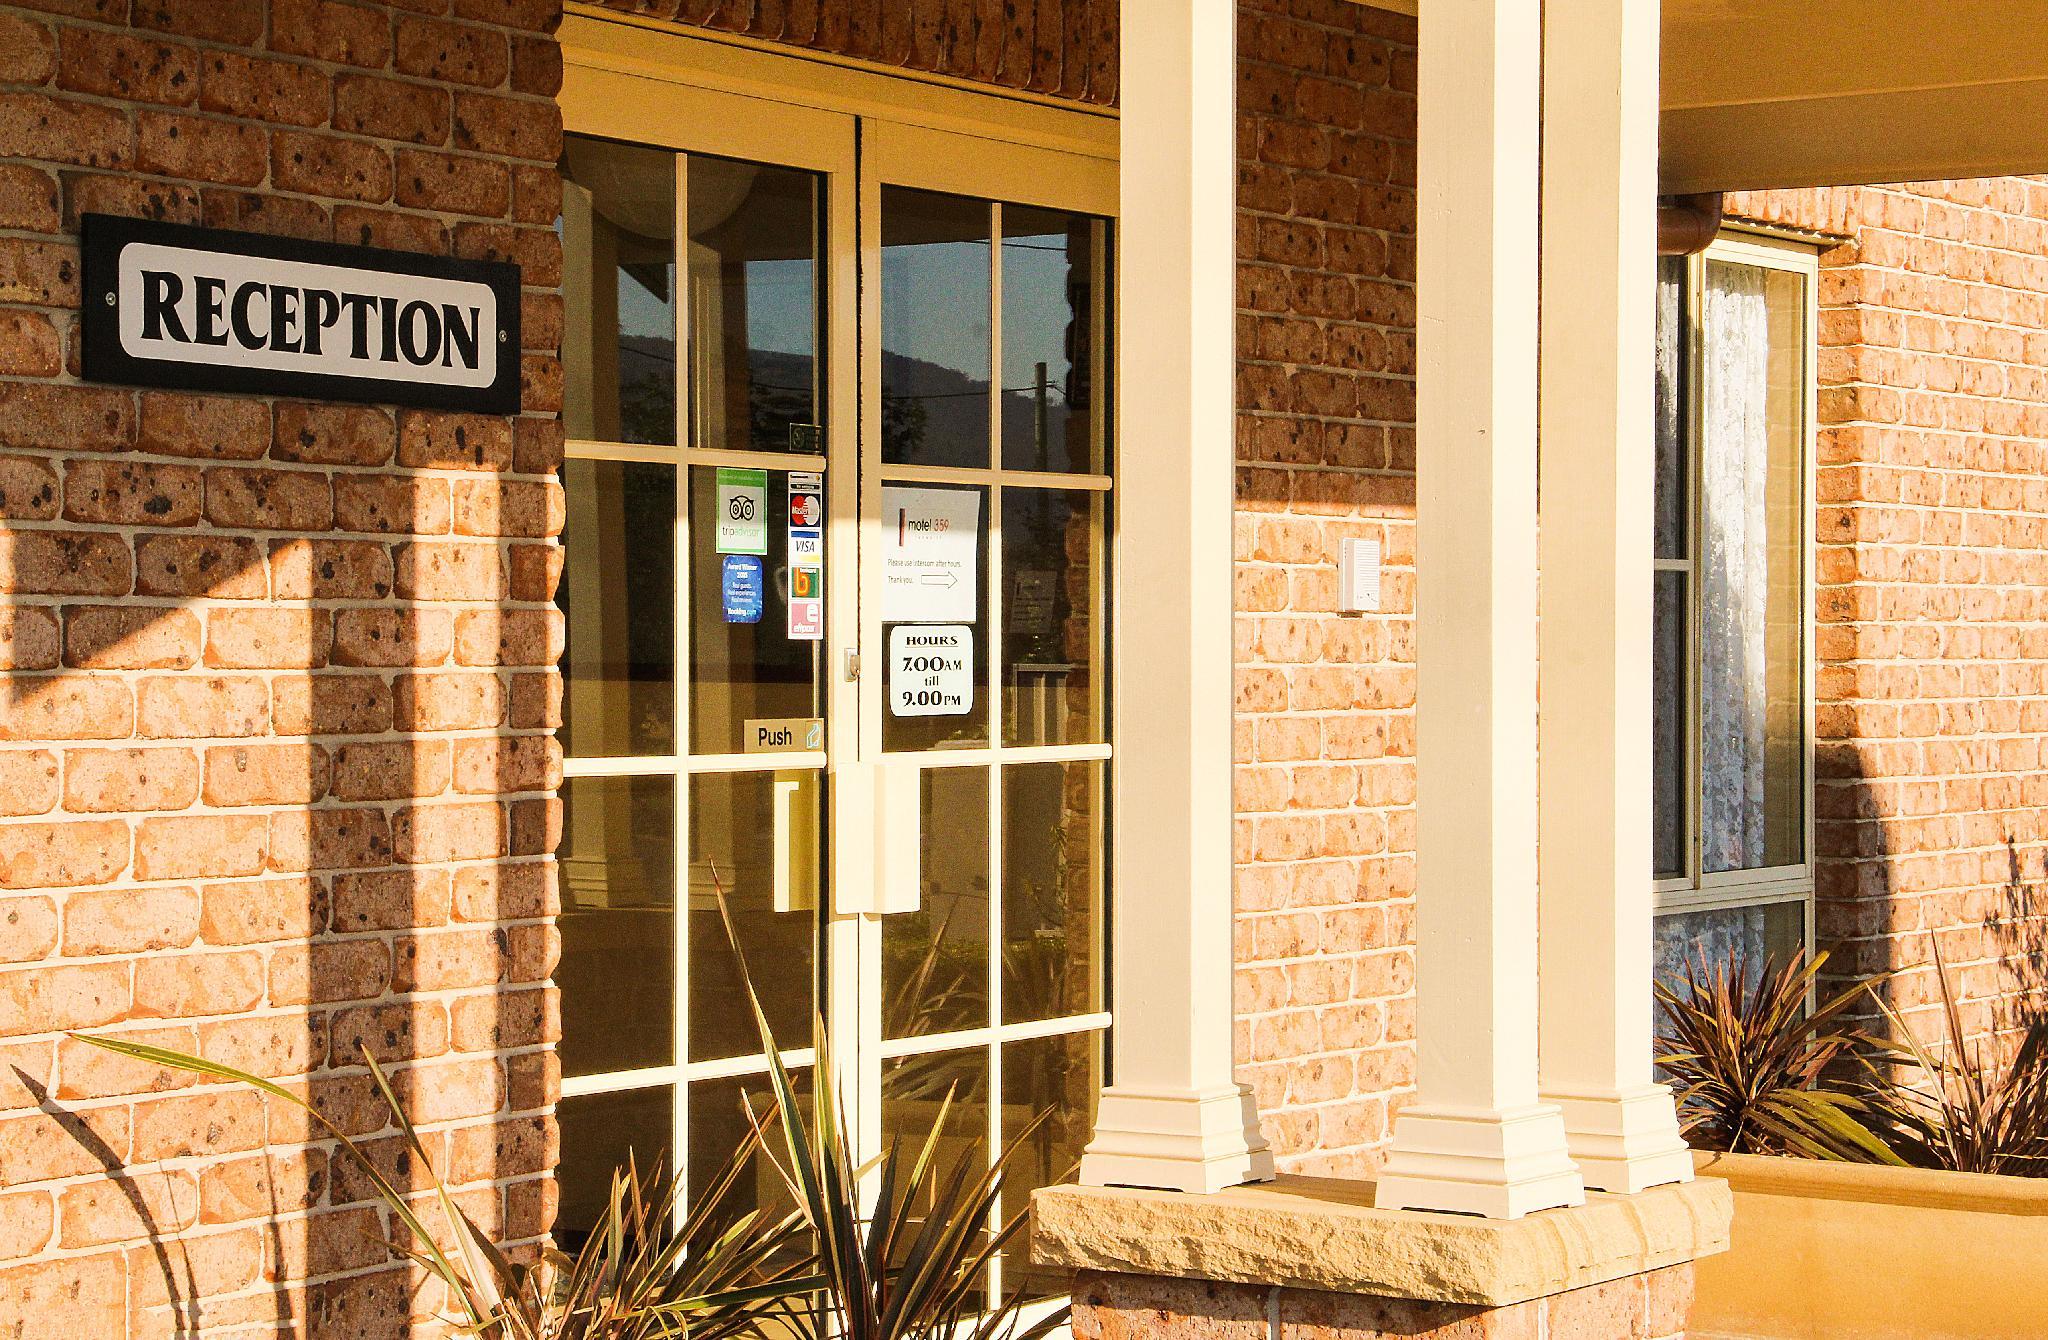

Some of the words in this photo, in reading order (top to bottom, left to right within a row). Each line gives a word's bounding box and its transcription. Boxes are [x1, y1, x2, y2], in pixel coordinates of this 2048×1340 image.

[140, 270, 481, 369] RECEPTION
[908, 518, 932, 531] motel
[934, 518, 950, 531] 359
[722, 525, 761, 537] tripadvisor
[796, 541, 815, 553] VISA
[906, 636, 958, 646] HOURS
[924, 675, 939, 686] till
[758, 726, 792, 746] Push
